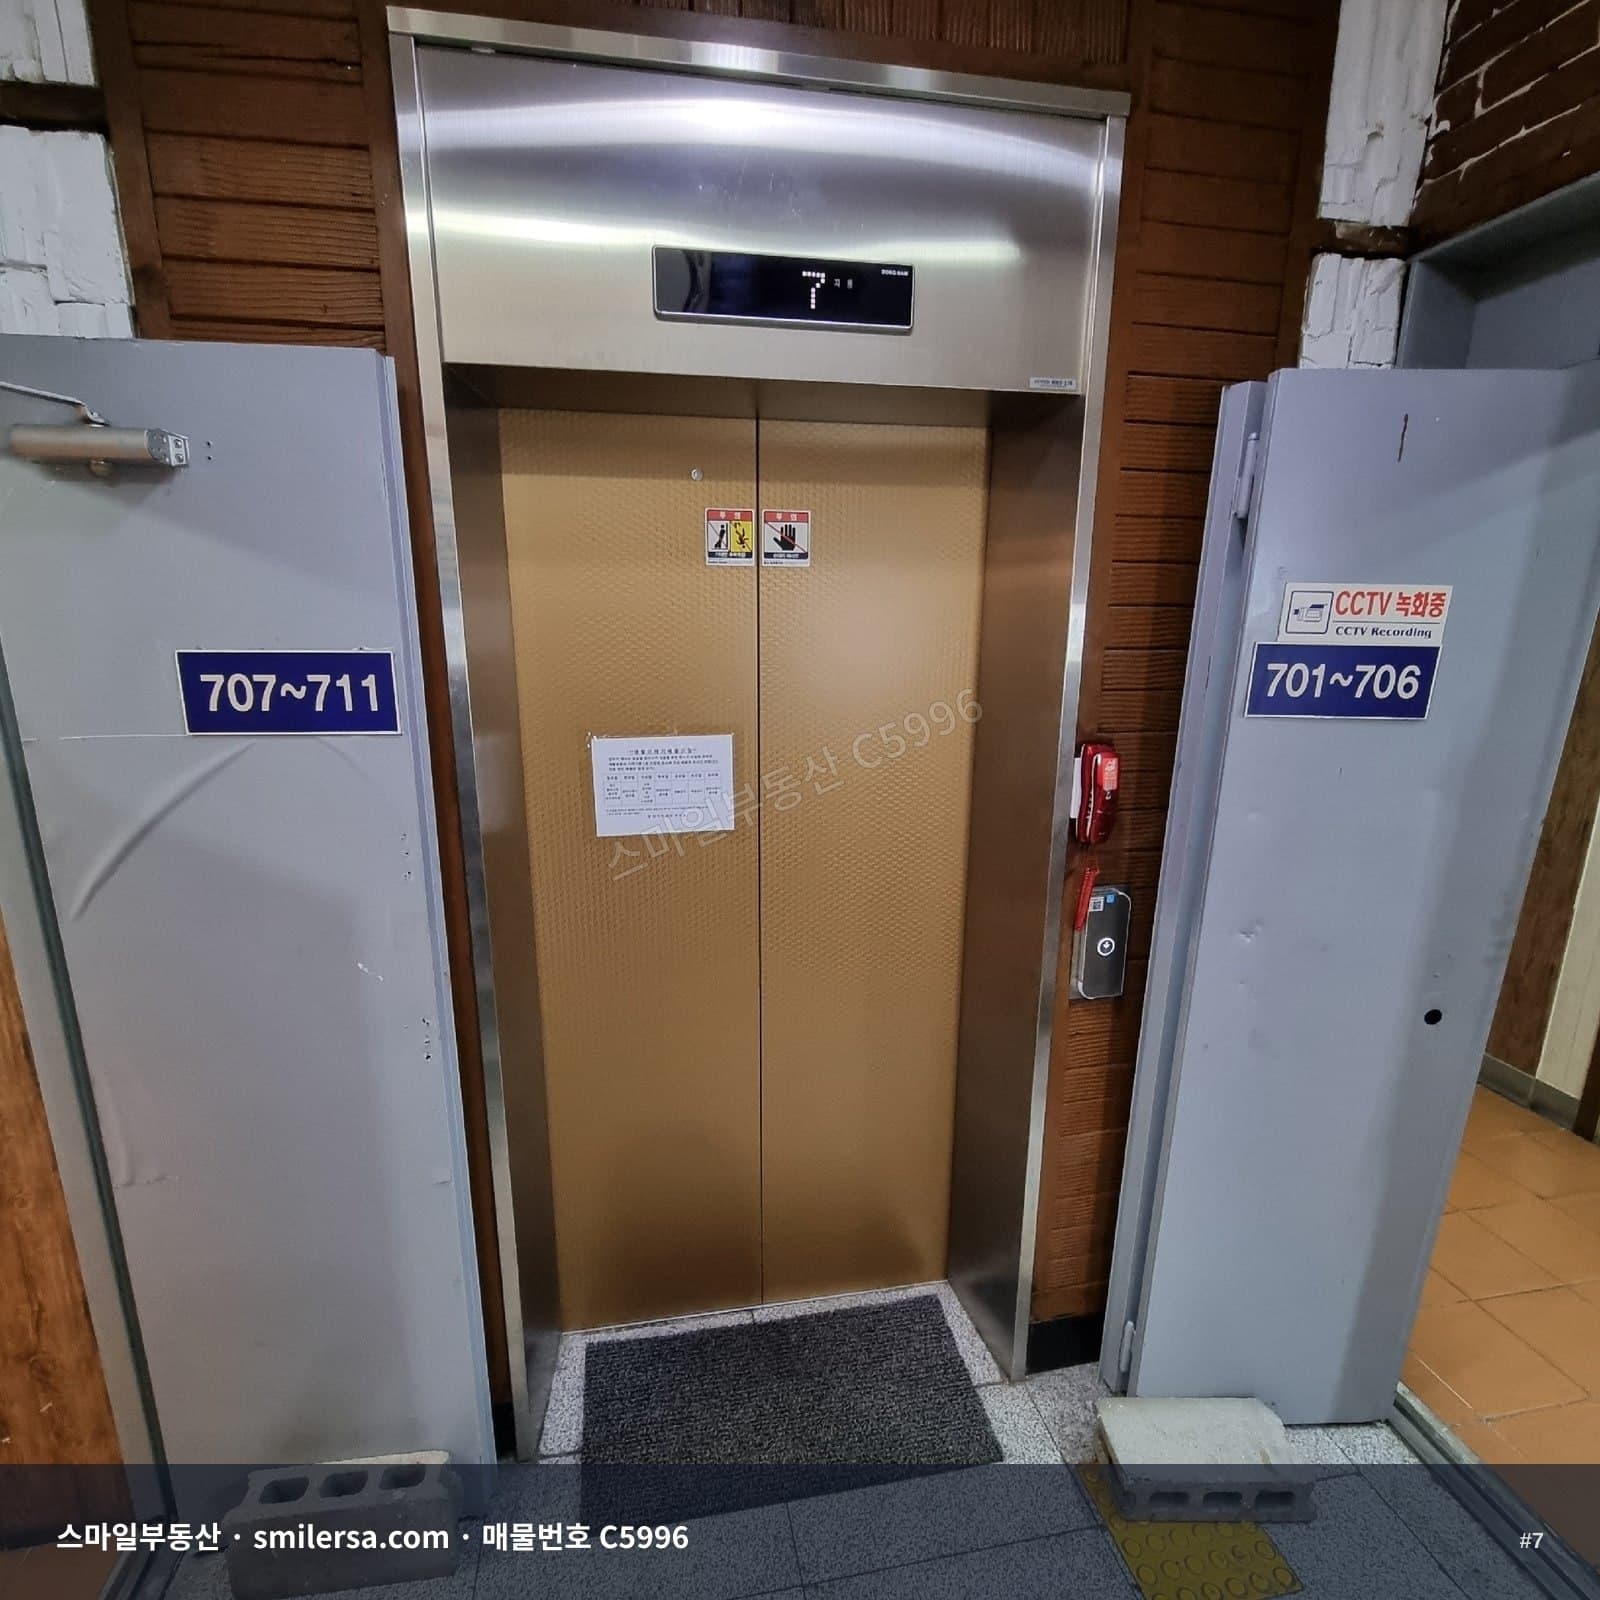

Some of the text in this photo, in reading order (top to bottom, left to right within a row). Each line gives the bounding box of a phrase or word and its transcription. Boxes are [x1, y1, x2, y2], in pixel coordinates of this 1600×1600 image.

[802, 270, 826, 310] 7
[1336, 590, 1446, 618] CCTV 녹화중
[1335, 626, 1432, 639] CCTV Recording
[199, 673, 378, 713] 707~711
[1266, 662, 1422, 701] 701~706
